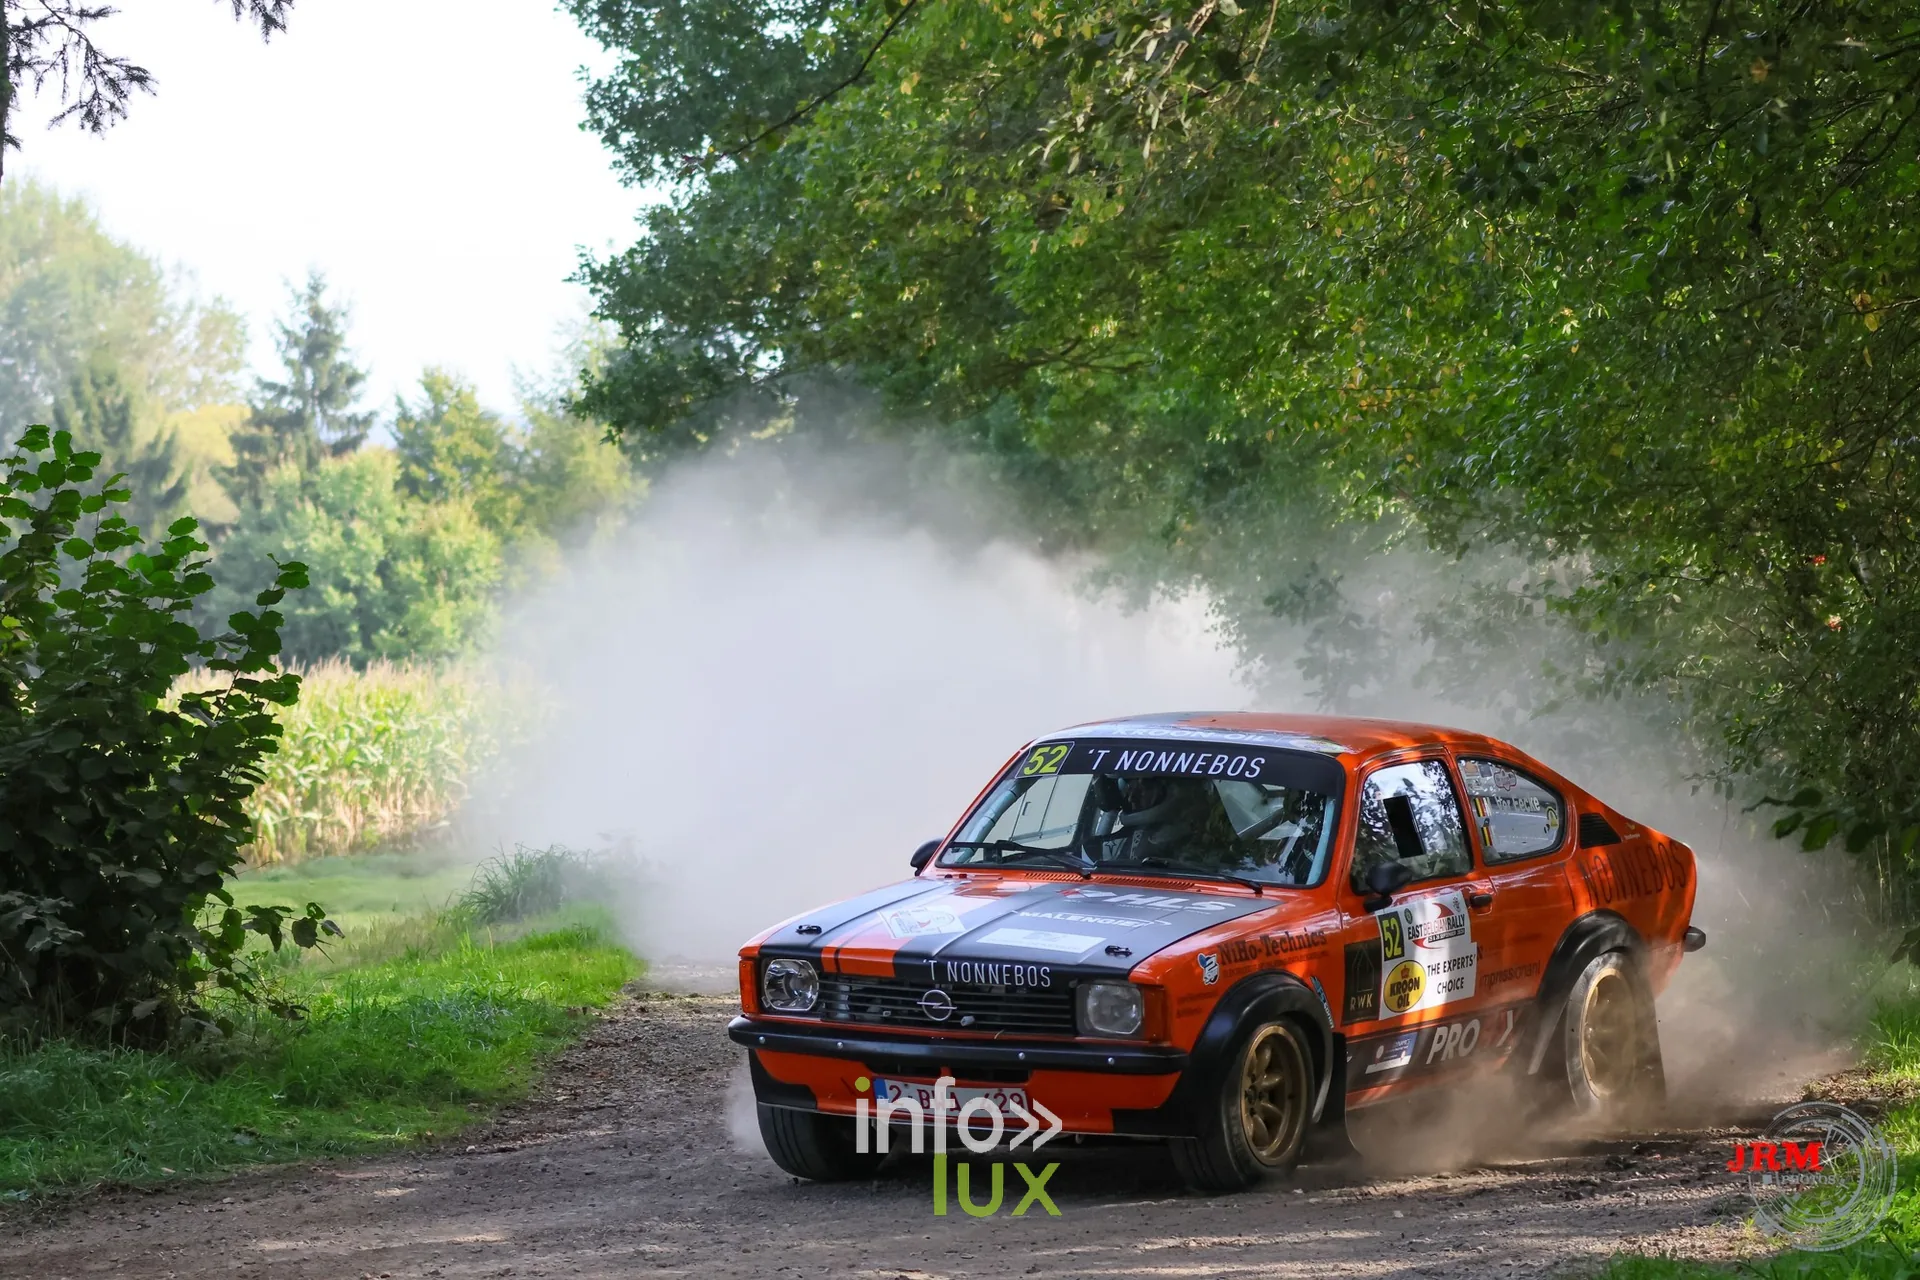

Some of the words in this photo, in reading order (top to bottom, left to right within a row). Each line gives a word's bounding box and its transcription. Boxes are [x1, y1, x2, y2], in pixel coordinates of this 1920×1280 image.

[1024, 745, 1068, 775] 52
[1115, 750, 1267, 778] NONNEBOS
[1577, 839, 1686, 907] NONNEBOS
[1383, 917, 1402, 958] 52
[947, 962, 1051, 987] NONNEBOS
[1427, 964, 1440, 976] THE
[1389, 977, 1421, 997] KROON
[1437, 978, 1465, 994] CHOICE
[1350, 993, 1373, 1011] RWK
[1396, 993, 1410, 1008] OIL
[1426, 1018, 1481, 1065] PRO
